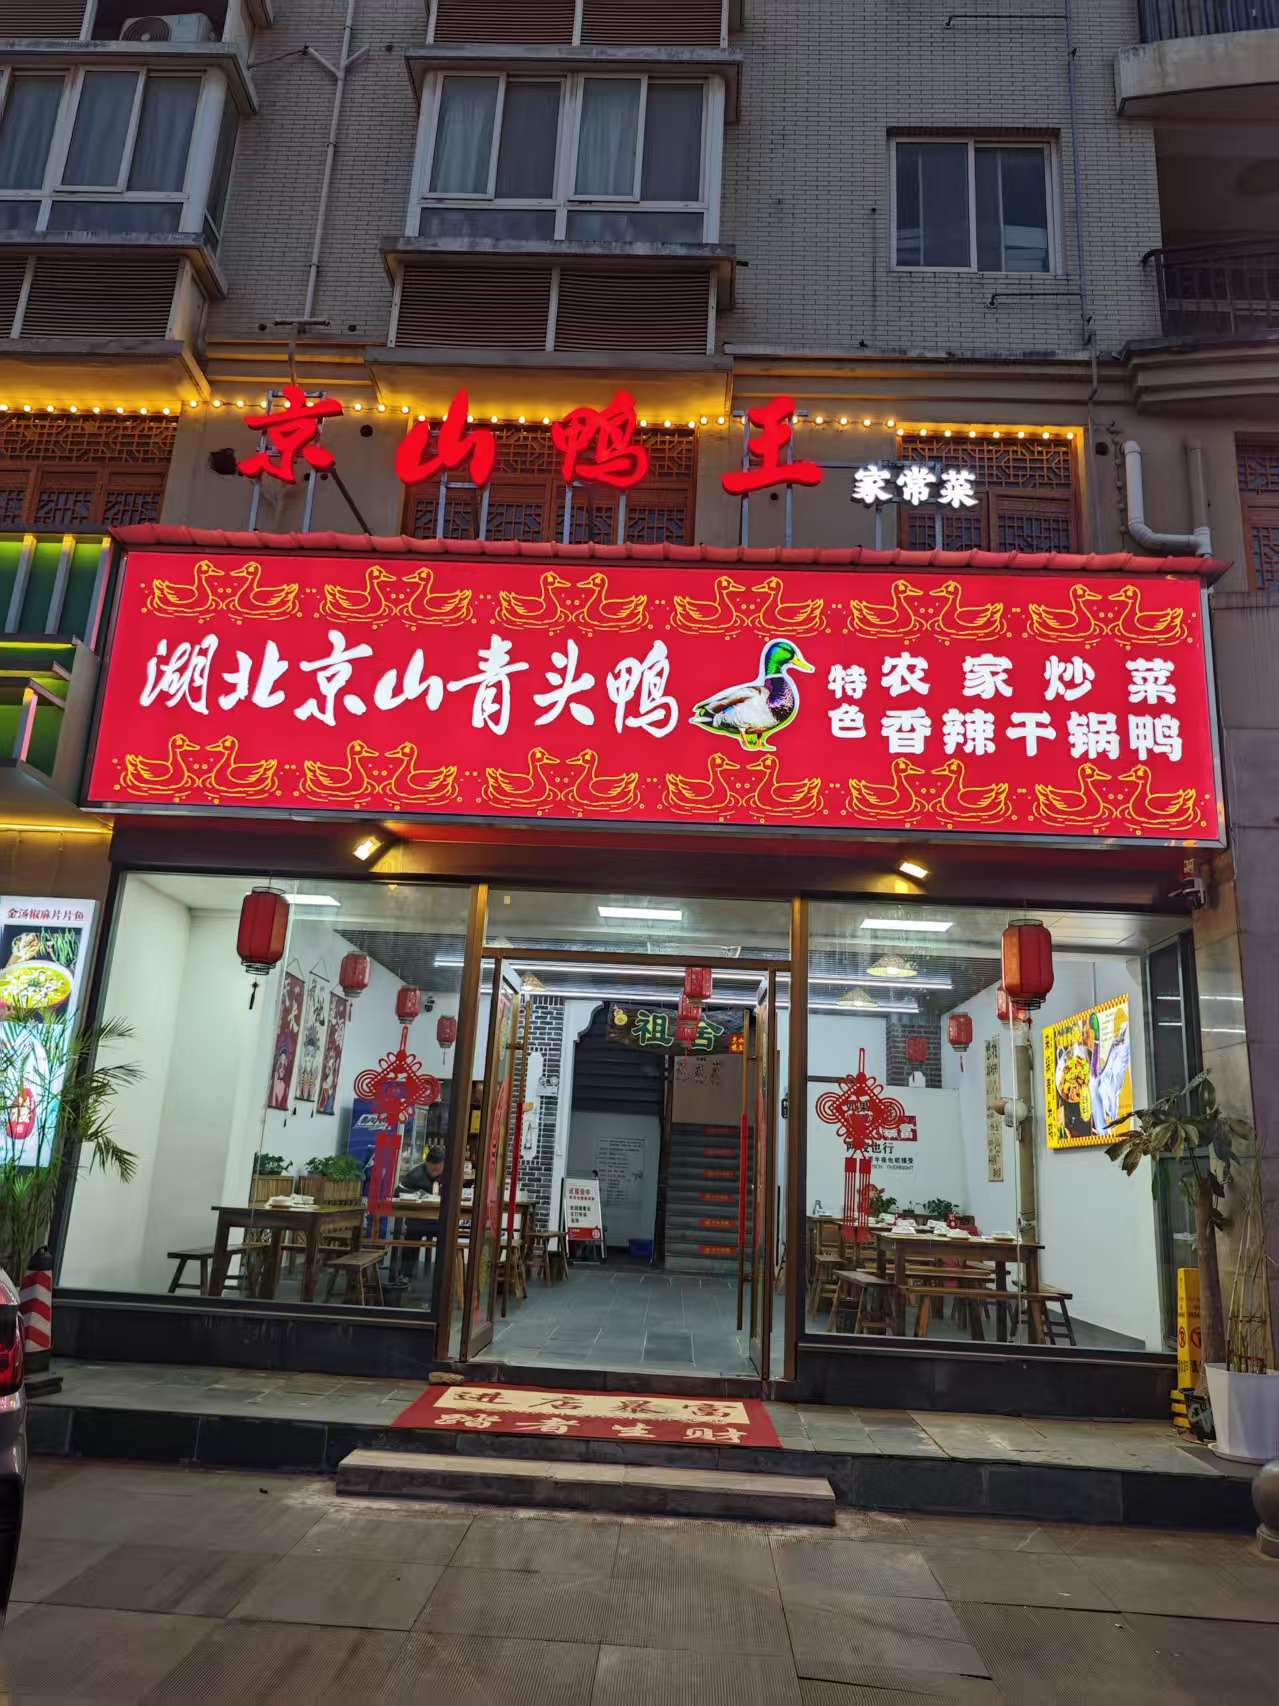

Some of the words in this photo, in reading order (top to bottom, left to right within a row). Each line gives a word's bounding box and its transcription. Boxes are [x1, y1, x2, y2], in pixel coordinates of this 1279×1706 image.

[239, 387, 823, 493] 京山鸭王
[852, 465, 980, 510] 家常菜
[140, 630, 680, 740] 湖北京山青头鸭
[828, 664, 869, 740] 特色
[882, 653, 1177, 706] 农家炒菜
[882, 708, 1184, 763] 香辣干锅鸭
